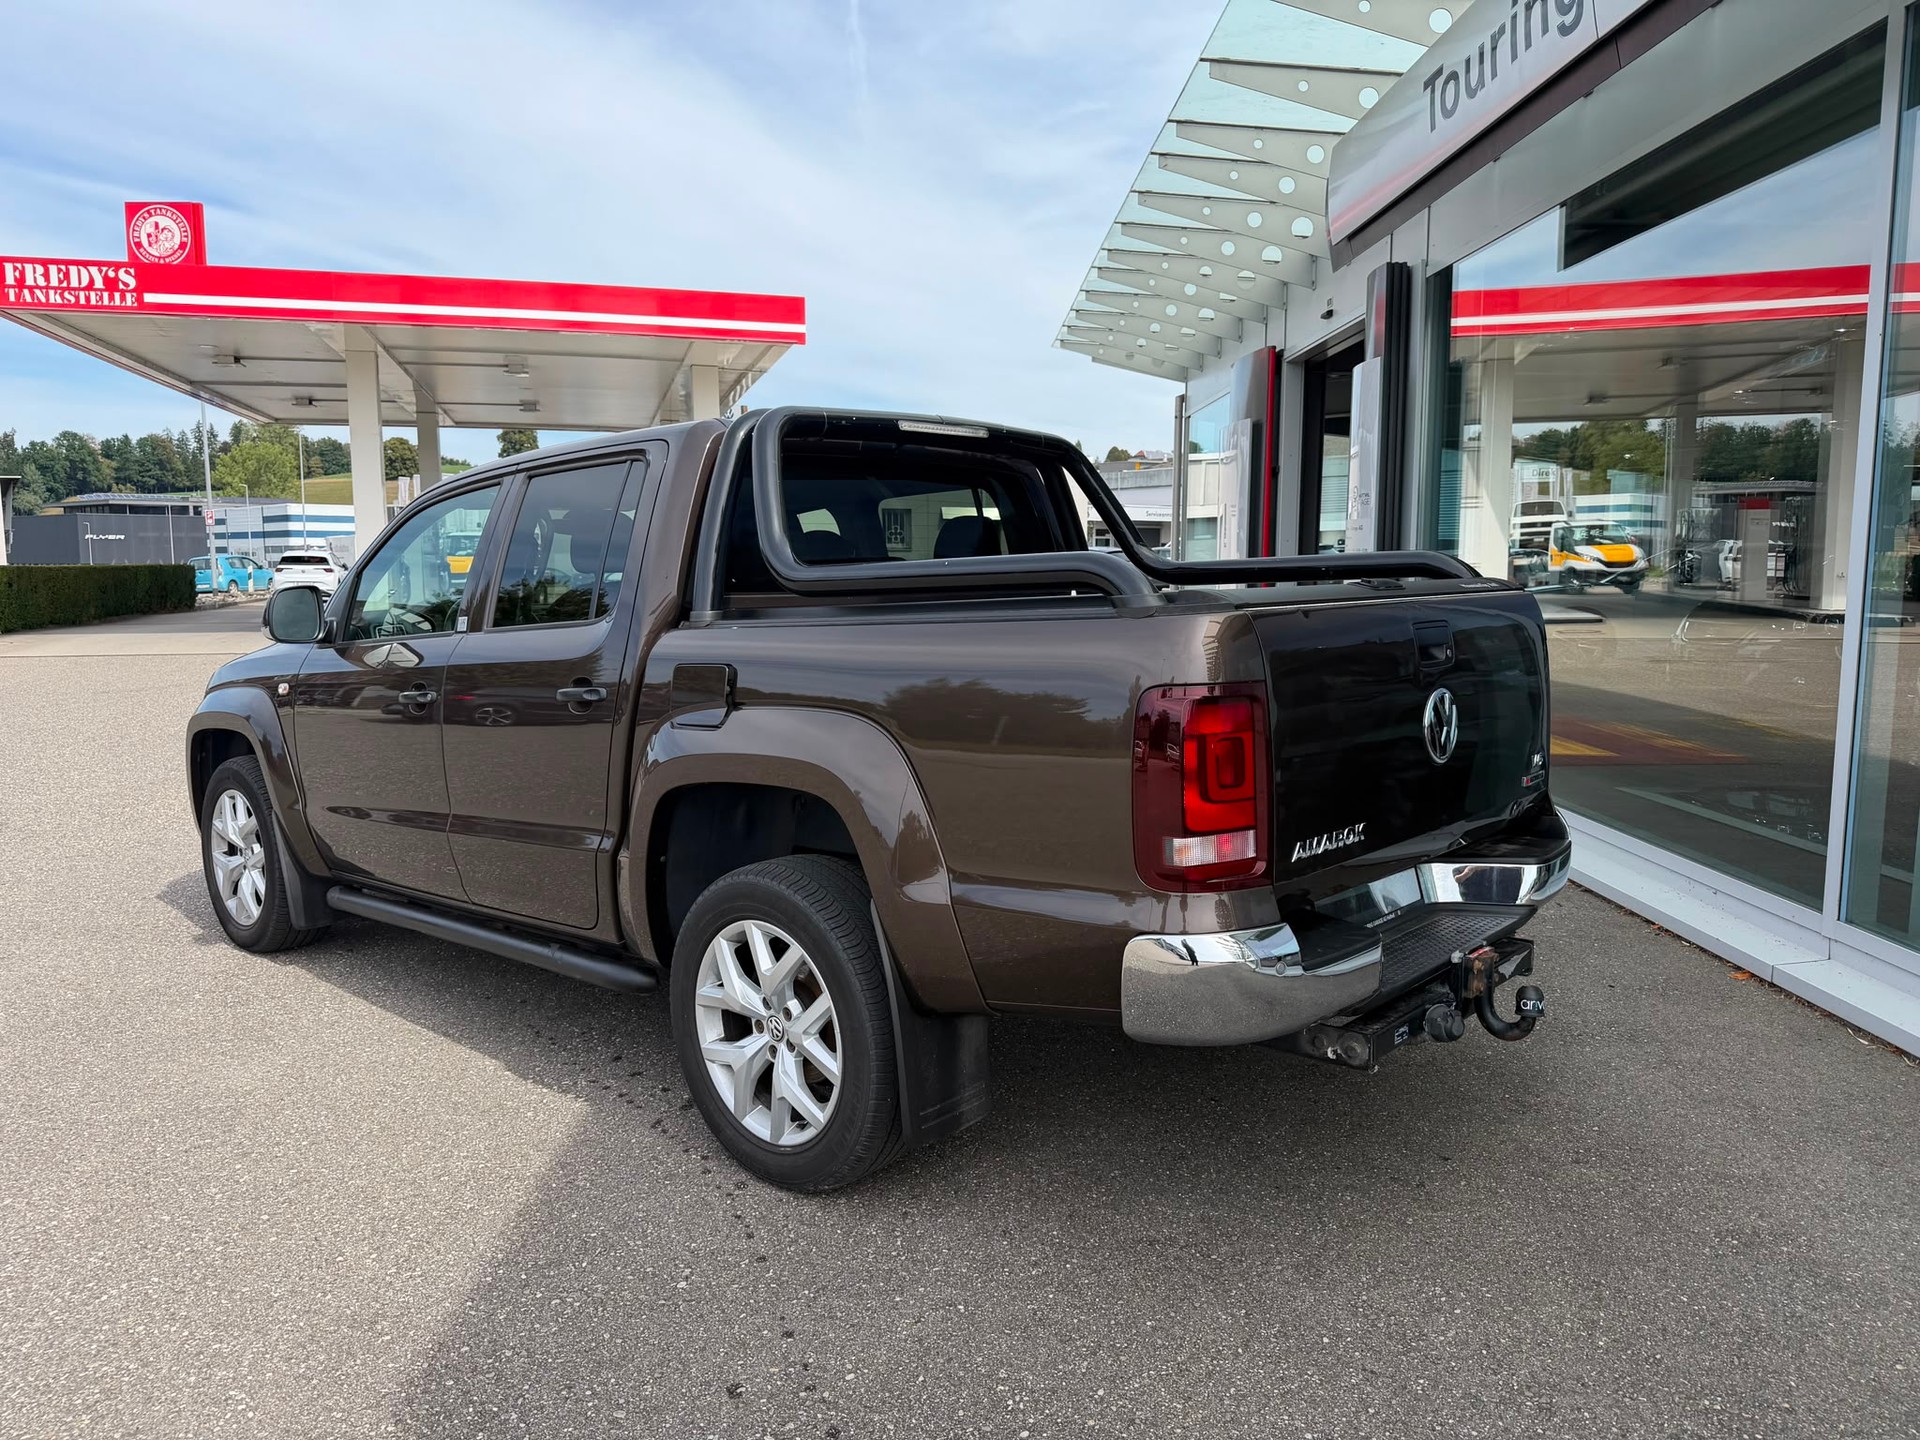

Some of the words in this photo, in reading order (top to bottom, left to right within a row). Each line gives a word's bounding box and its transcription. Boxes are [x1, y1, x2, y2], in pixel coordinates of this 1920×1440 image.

[1423, 0, 1584, 133] Touring
[150, 207, 188, 243] TANKSTELLE
[5, 288, 138, 306] TANKSTELLE
[1291, 822, 1366, 863] AMAROK
